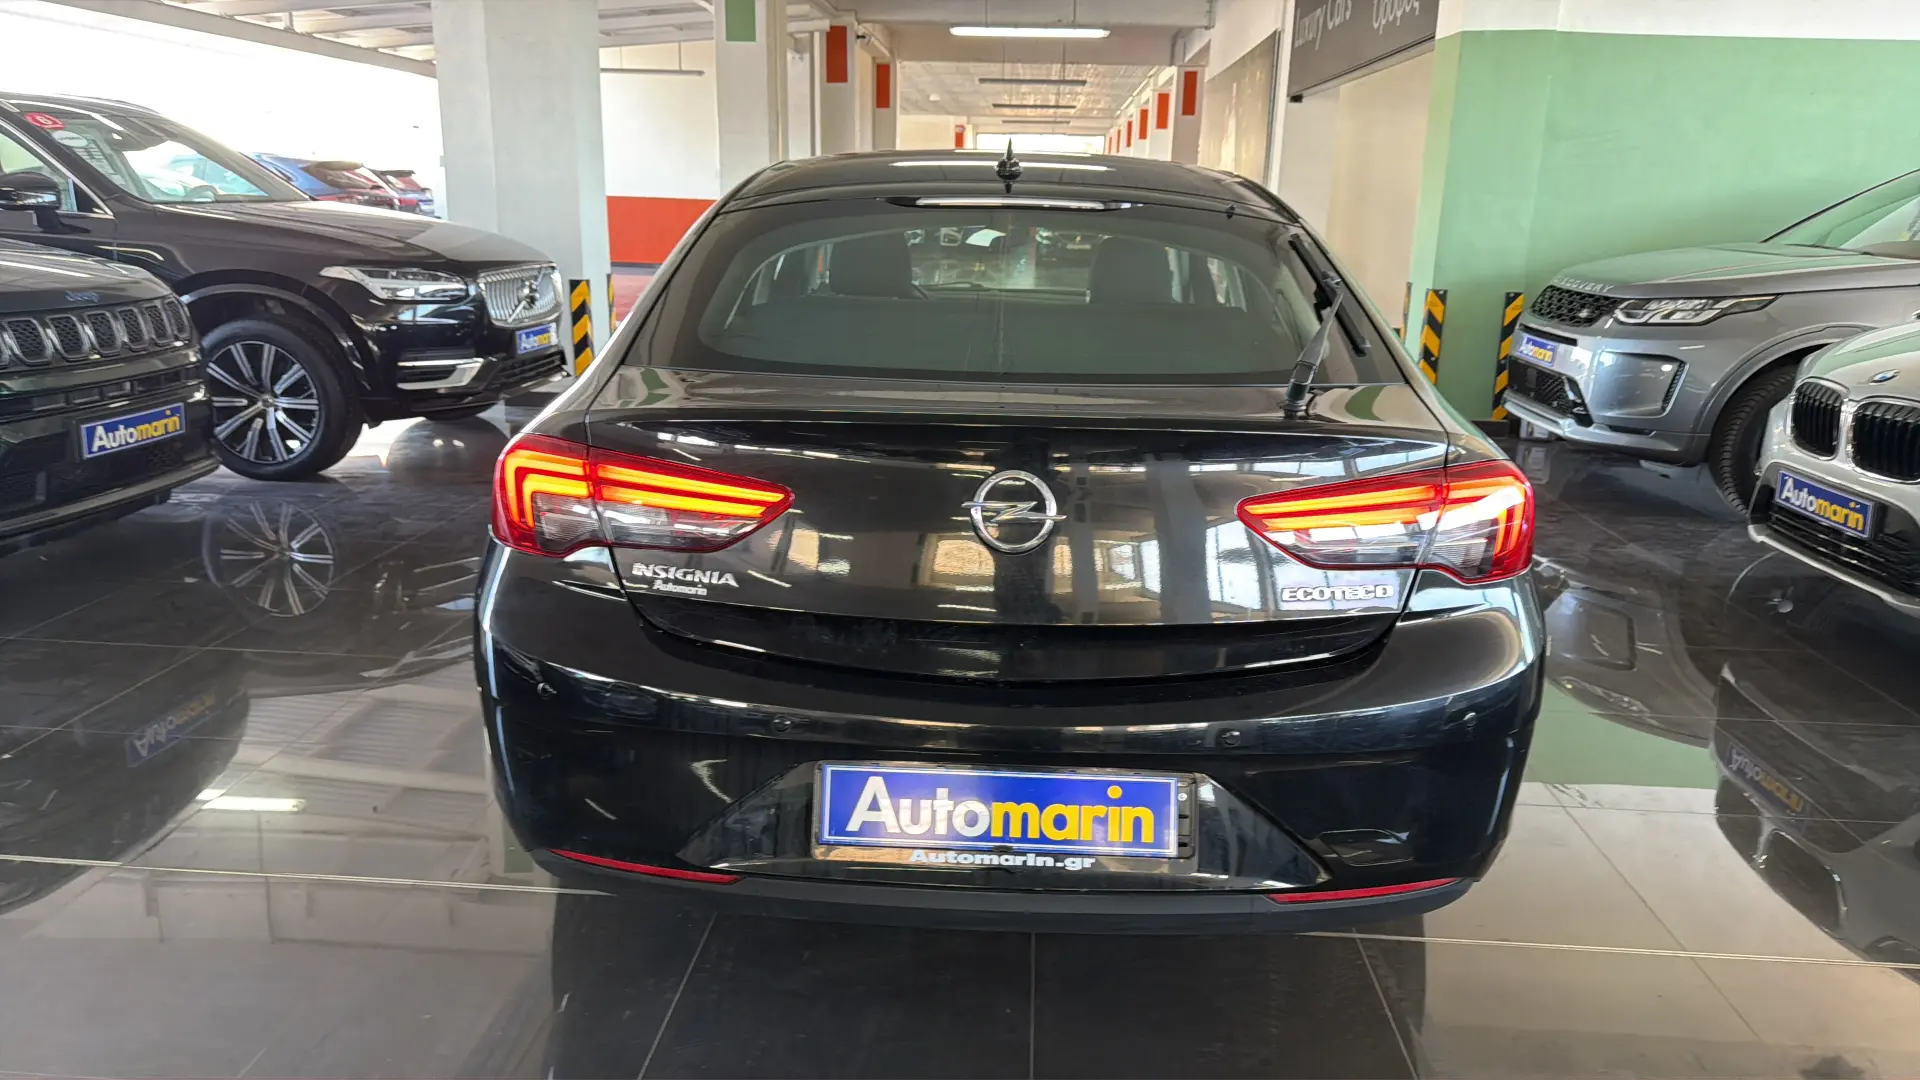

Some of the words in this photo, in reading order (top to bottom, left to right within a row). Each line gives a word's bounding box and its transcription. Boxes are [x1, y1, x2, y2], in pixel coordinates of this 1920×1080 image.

[1294, 4, 1327, 50] Luxury
[1327, 0, 1353, 30] Cars
[520, 327, 556, 351] Automar
[92, 410, 181, 452] Automarin
[1780, 478, 1865, 531] Automarin
[631, 562, 739, 588] INSIGNIA
[652, 580, 708, 596] Automarin
[845, 776, 1155, 843] Automarin
[911, 850, 1097, 871] Automarin.gr
